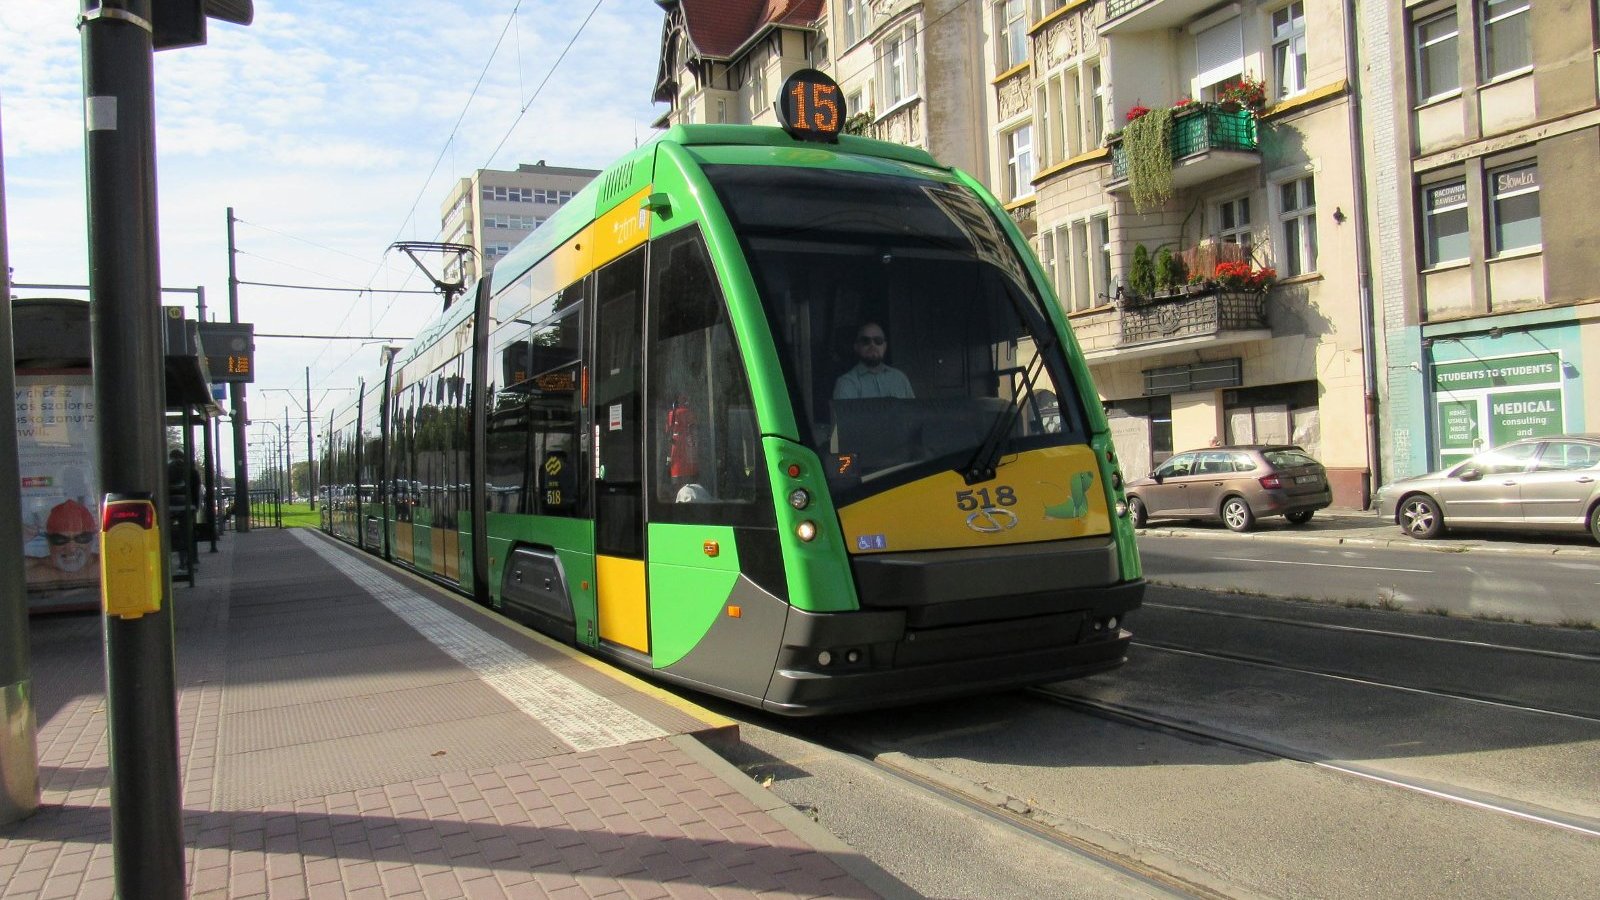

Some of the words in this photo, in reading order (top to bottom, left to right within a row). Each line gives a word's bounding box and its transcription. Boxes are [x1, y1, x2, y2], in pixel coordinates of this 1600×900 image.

[790, 81, 838, 131] 15
[1437, 370, 1485, 382] STUDENTS
[1487, 369, 1499, 377] TO
[1501, 363, 1553, 376] STUDENTS
[1493, 400, 1555, 416] MEDICAL
[1501, 417, 1547, 426] consulting
[1516, 427, 1533, 436] and
[839, 456, 851, 473] 7
[547, 490, 561, 505] 518
[956, 486, 1018, 511] 518
